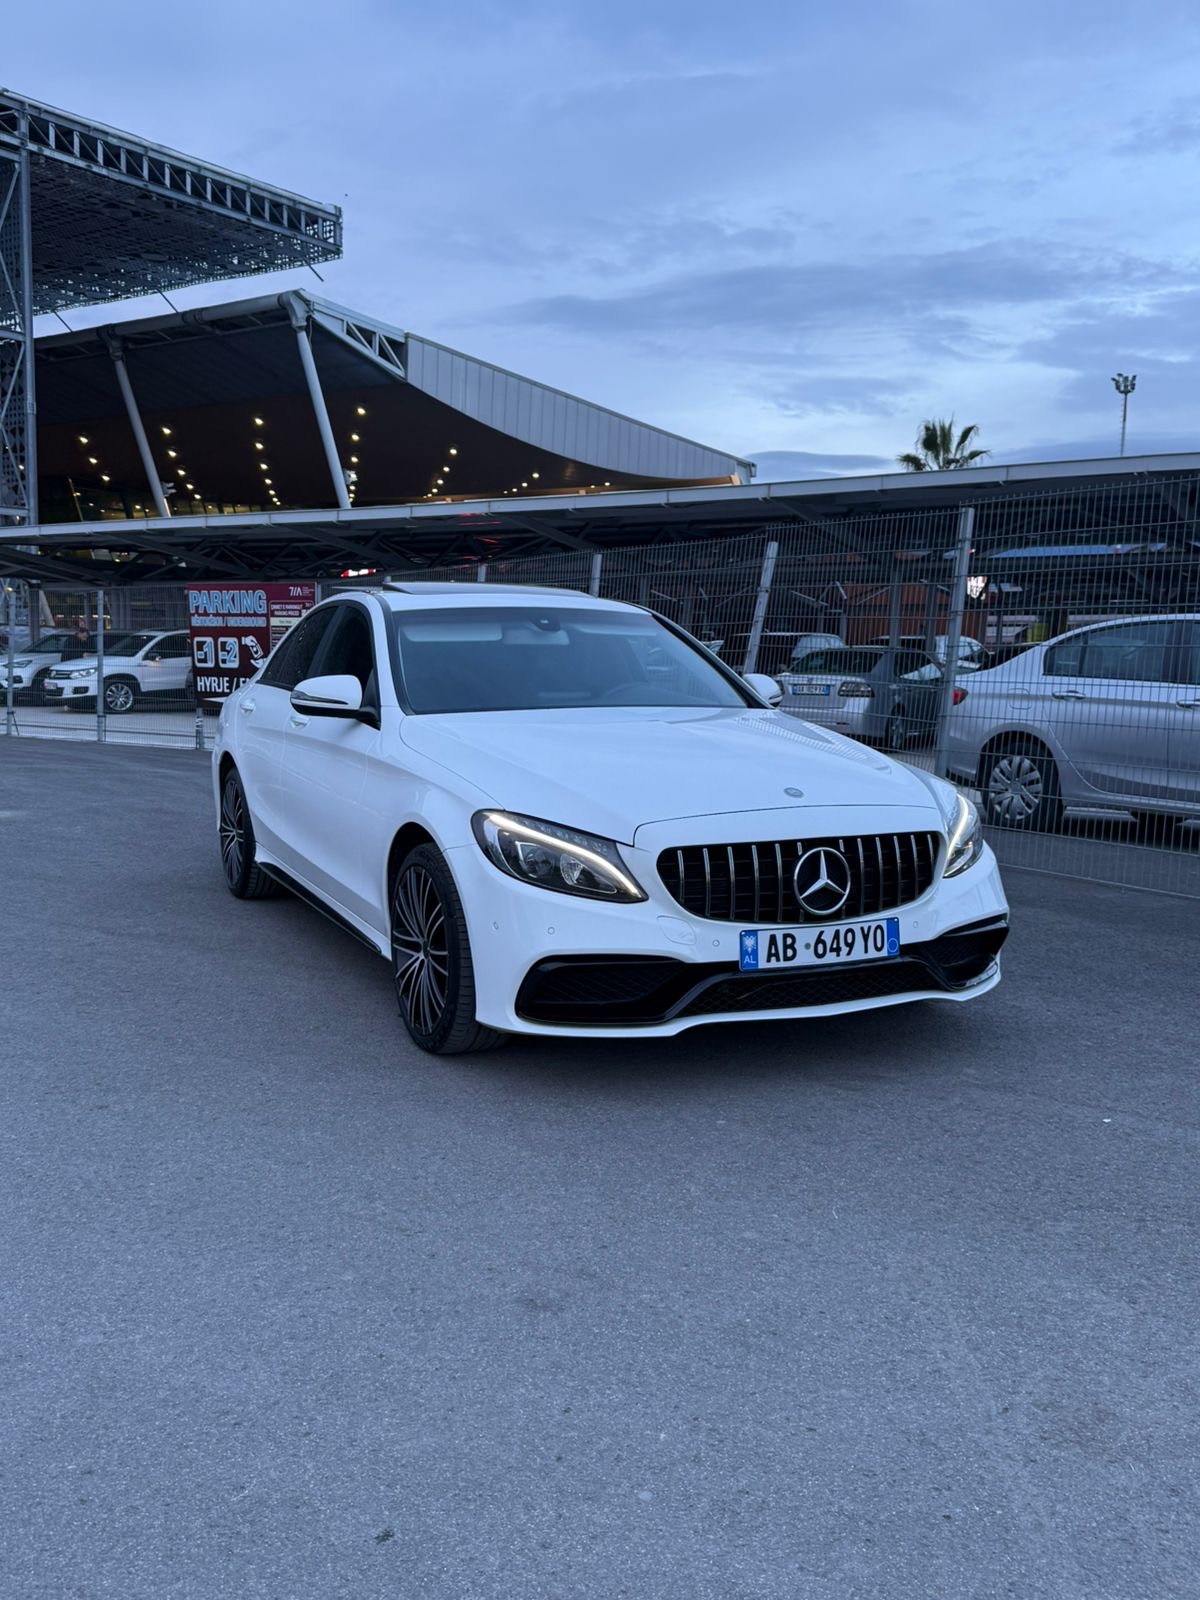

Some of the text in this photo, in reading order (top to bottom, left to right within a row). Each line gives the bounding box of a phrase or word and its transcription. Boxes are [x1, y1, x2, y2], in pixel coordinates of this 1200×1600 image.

[188, 589, 267, 614] PARKING
[196, 676, 230, 692] HYRJE
[766, 933, 797, 963] AB
[813, 927, 856, 959] 649
[743, 955, 757, 964] AL
